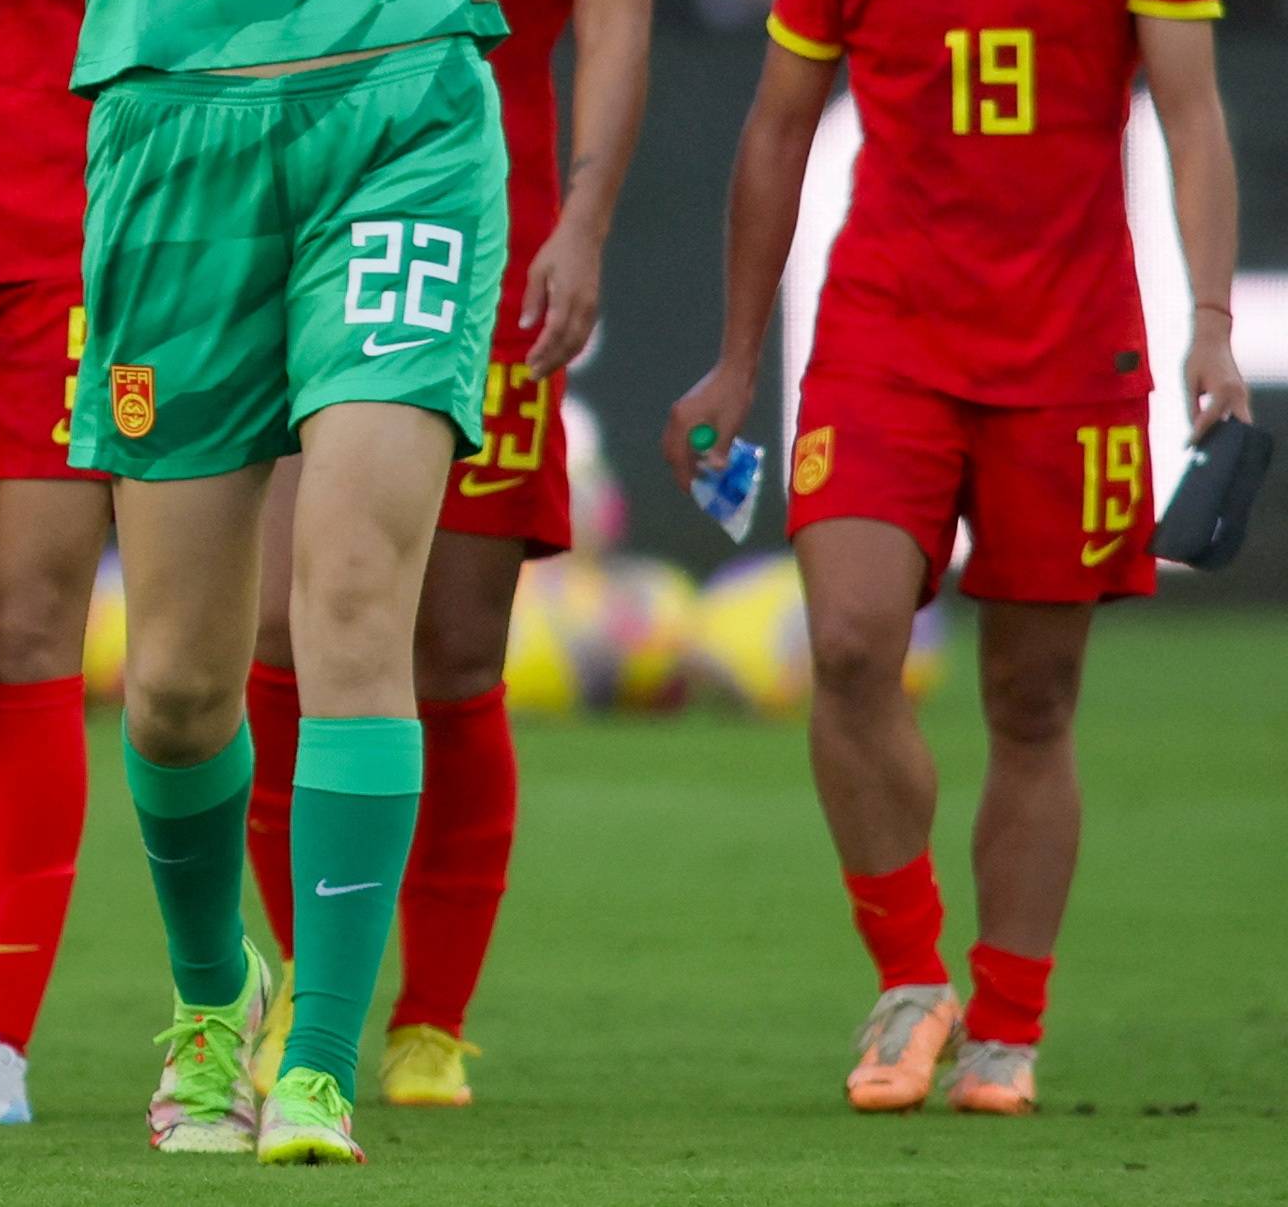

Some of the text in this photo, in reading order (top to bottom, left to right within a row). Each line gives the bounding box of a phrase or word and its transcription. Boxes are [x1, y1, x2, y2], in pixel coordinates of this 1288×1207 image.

[944, 28, 1036, 135] 19
[344, 221, 464, 333] 22
[116, 371, 149, 384] CFA
[1076, 426, 1144, 532] 19
